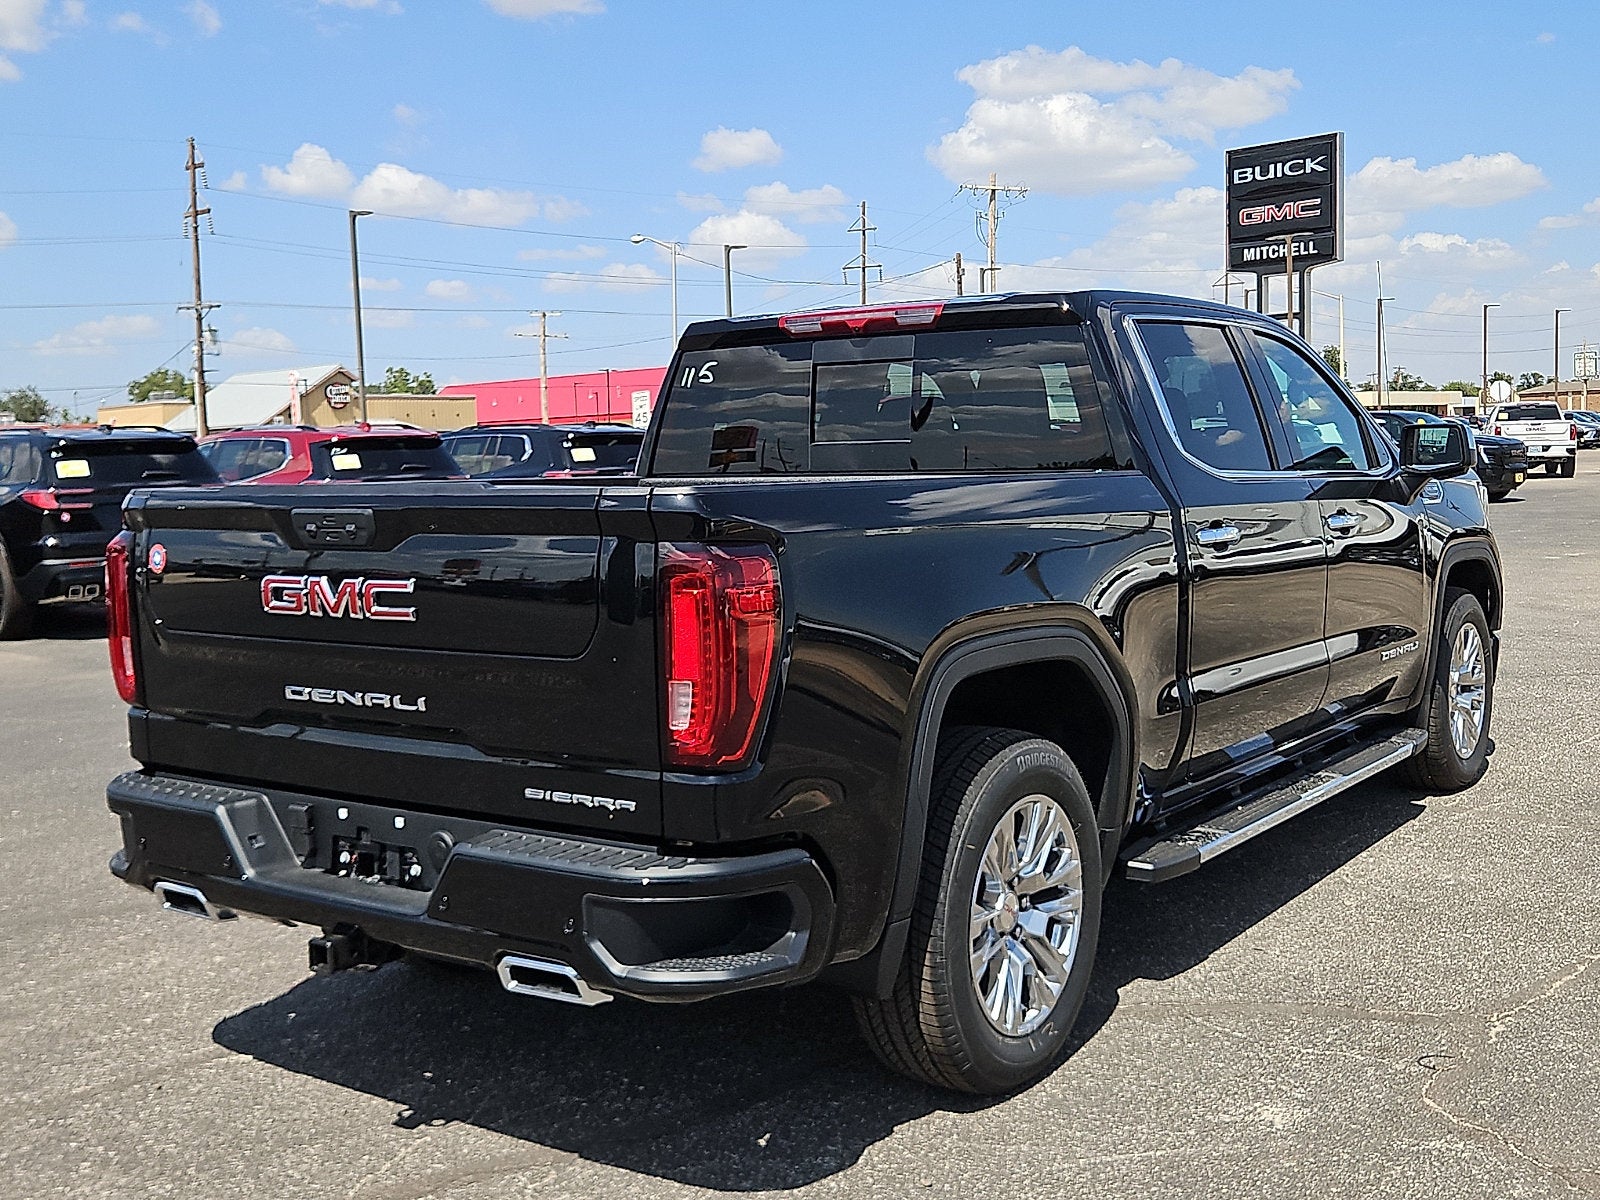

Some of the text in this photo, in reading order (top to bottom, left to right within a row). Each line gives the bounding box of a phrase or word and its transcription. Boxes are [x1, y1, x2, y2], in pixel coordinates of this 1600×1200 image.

[1233, 155, 1328, 184] BUICK
[1239, 198, 1321, 225] GMC
[1243, 241, 1318, 261] MITCHELL
[635, 412, 648, 423] 45
[261, 575, 416, 621] GMC
[285, 685, 426, 711] DENALI
[1016, 752, 1074, 777] BRIDGESTONE
[524, 787, 637, 812] SIERRA
